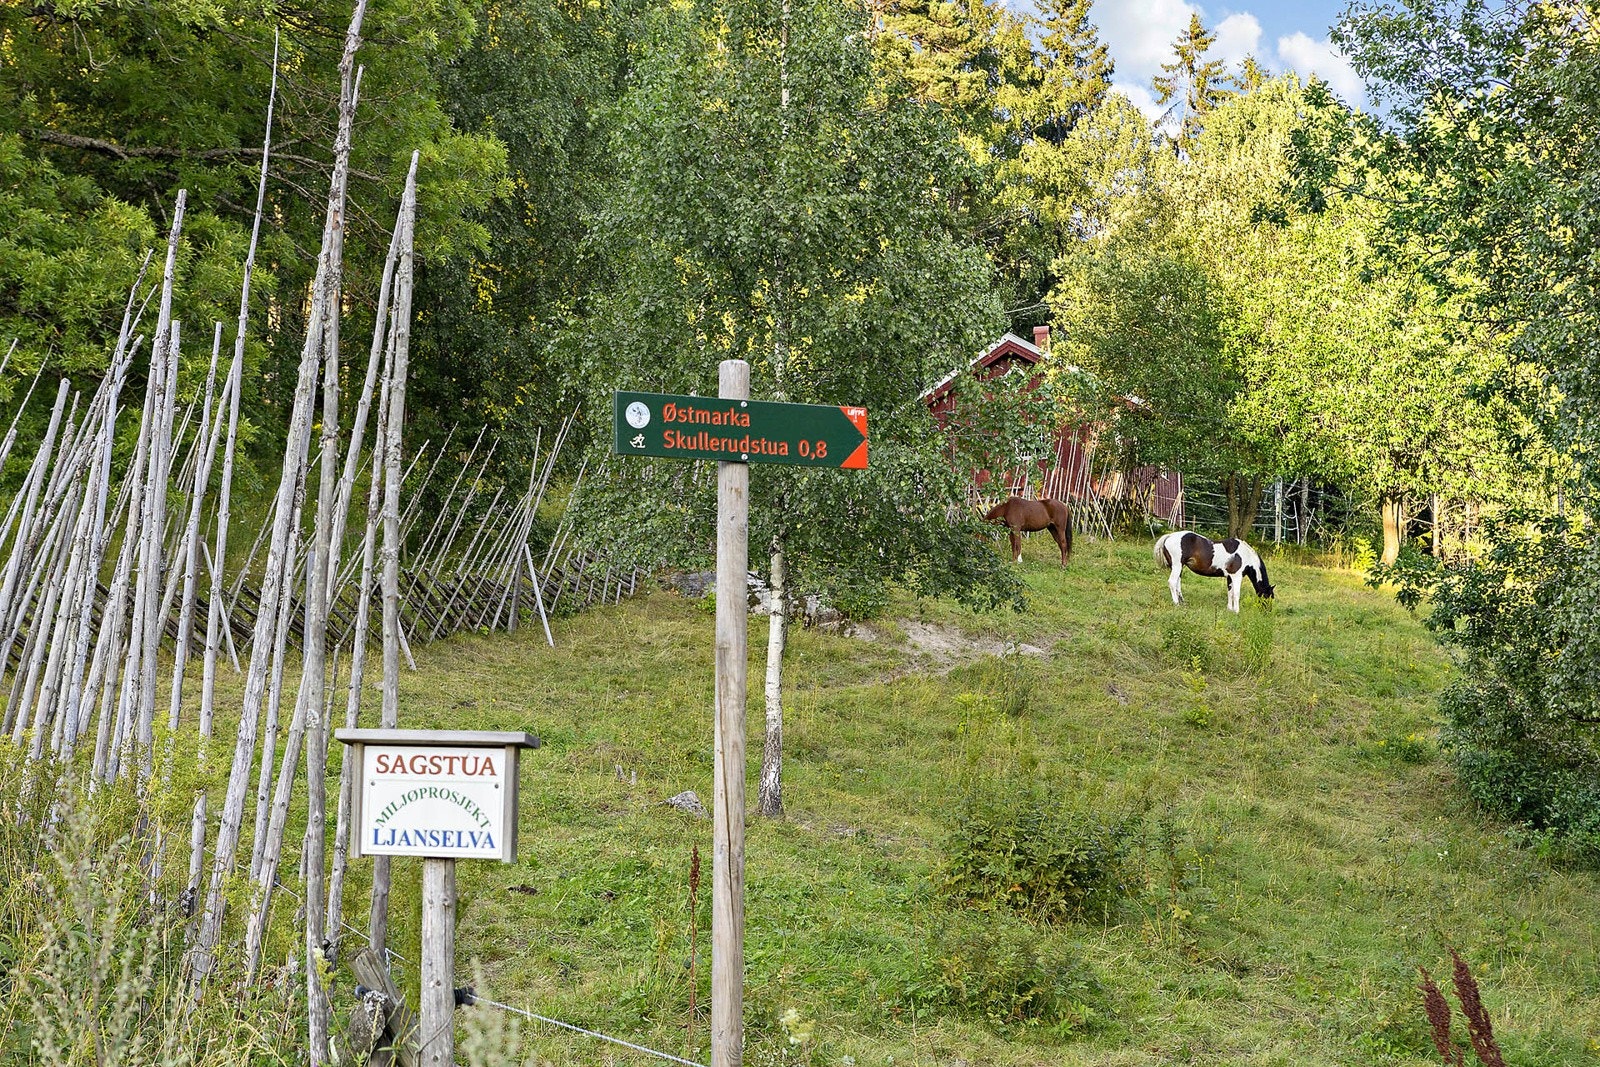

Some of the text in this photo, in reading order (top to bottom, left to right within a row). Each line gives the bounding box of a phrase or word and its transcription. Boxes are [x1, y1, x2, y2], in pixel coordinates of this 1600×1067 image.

[662, 402, 751, 428] Østmarka
[662, 429, 828, 460] Skullerudstua 0,8
[376, 754, 497, 776] SAGSTUA
[375, 786, 492, 830] MILJØPROSJEKT
[373, 828, 496, 849] LJANSELVA
